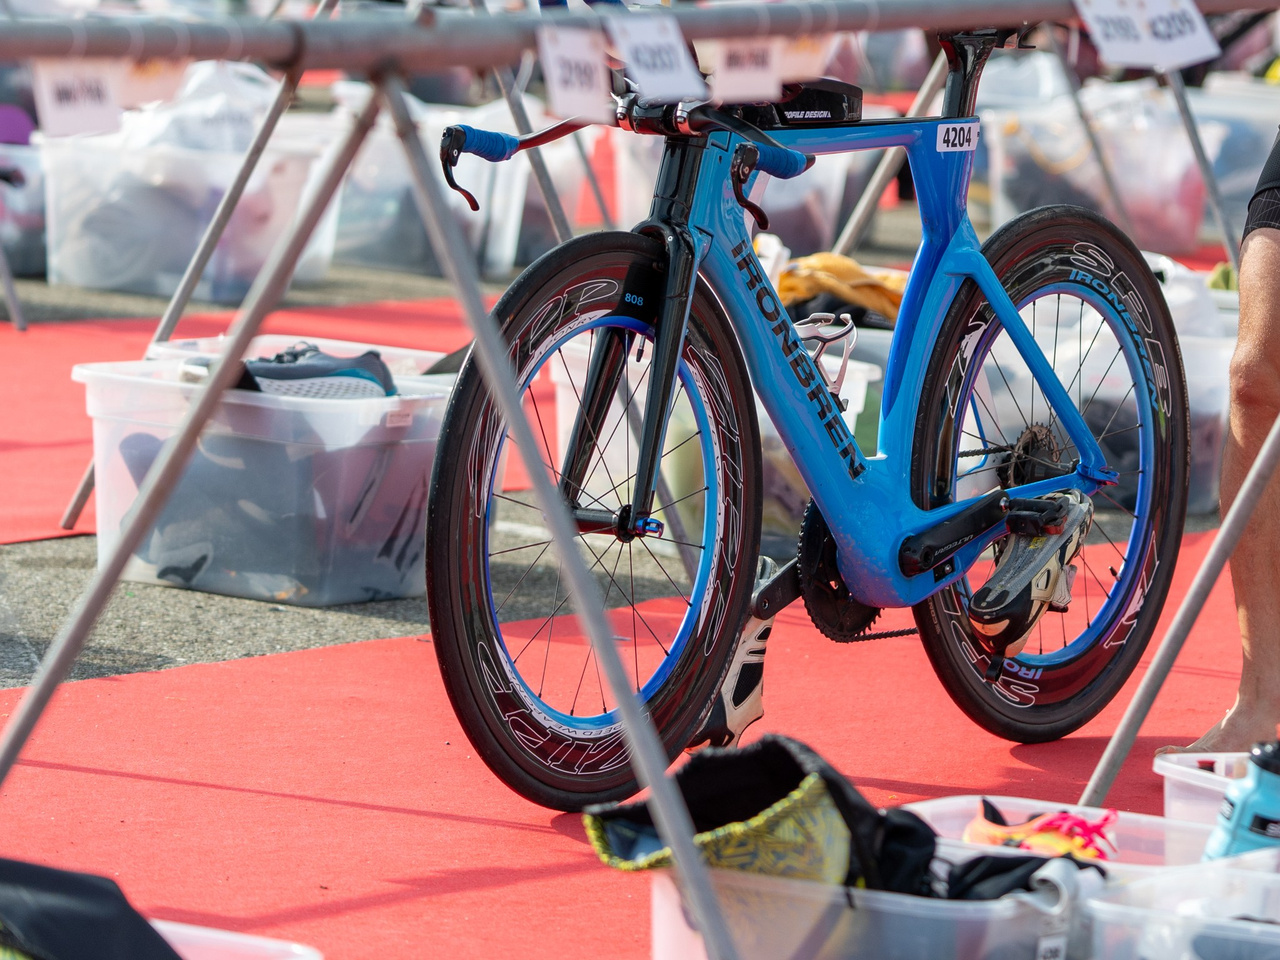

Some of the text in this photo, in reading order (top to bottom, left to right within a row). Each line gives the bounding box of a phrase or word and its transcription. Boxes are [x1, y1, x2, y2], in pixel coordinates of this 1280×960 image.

[804, 110, 828, 118] DESIGN
[942, 126, 972, 148] 4204
[624, 292, 644, 306] 808
[1068, 269, 1159, 412] IRONBREN
[731, 239, 867, 481] IRONBREN
